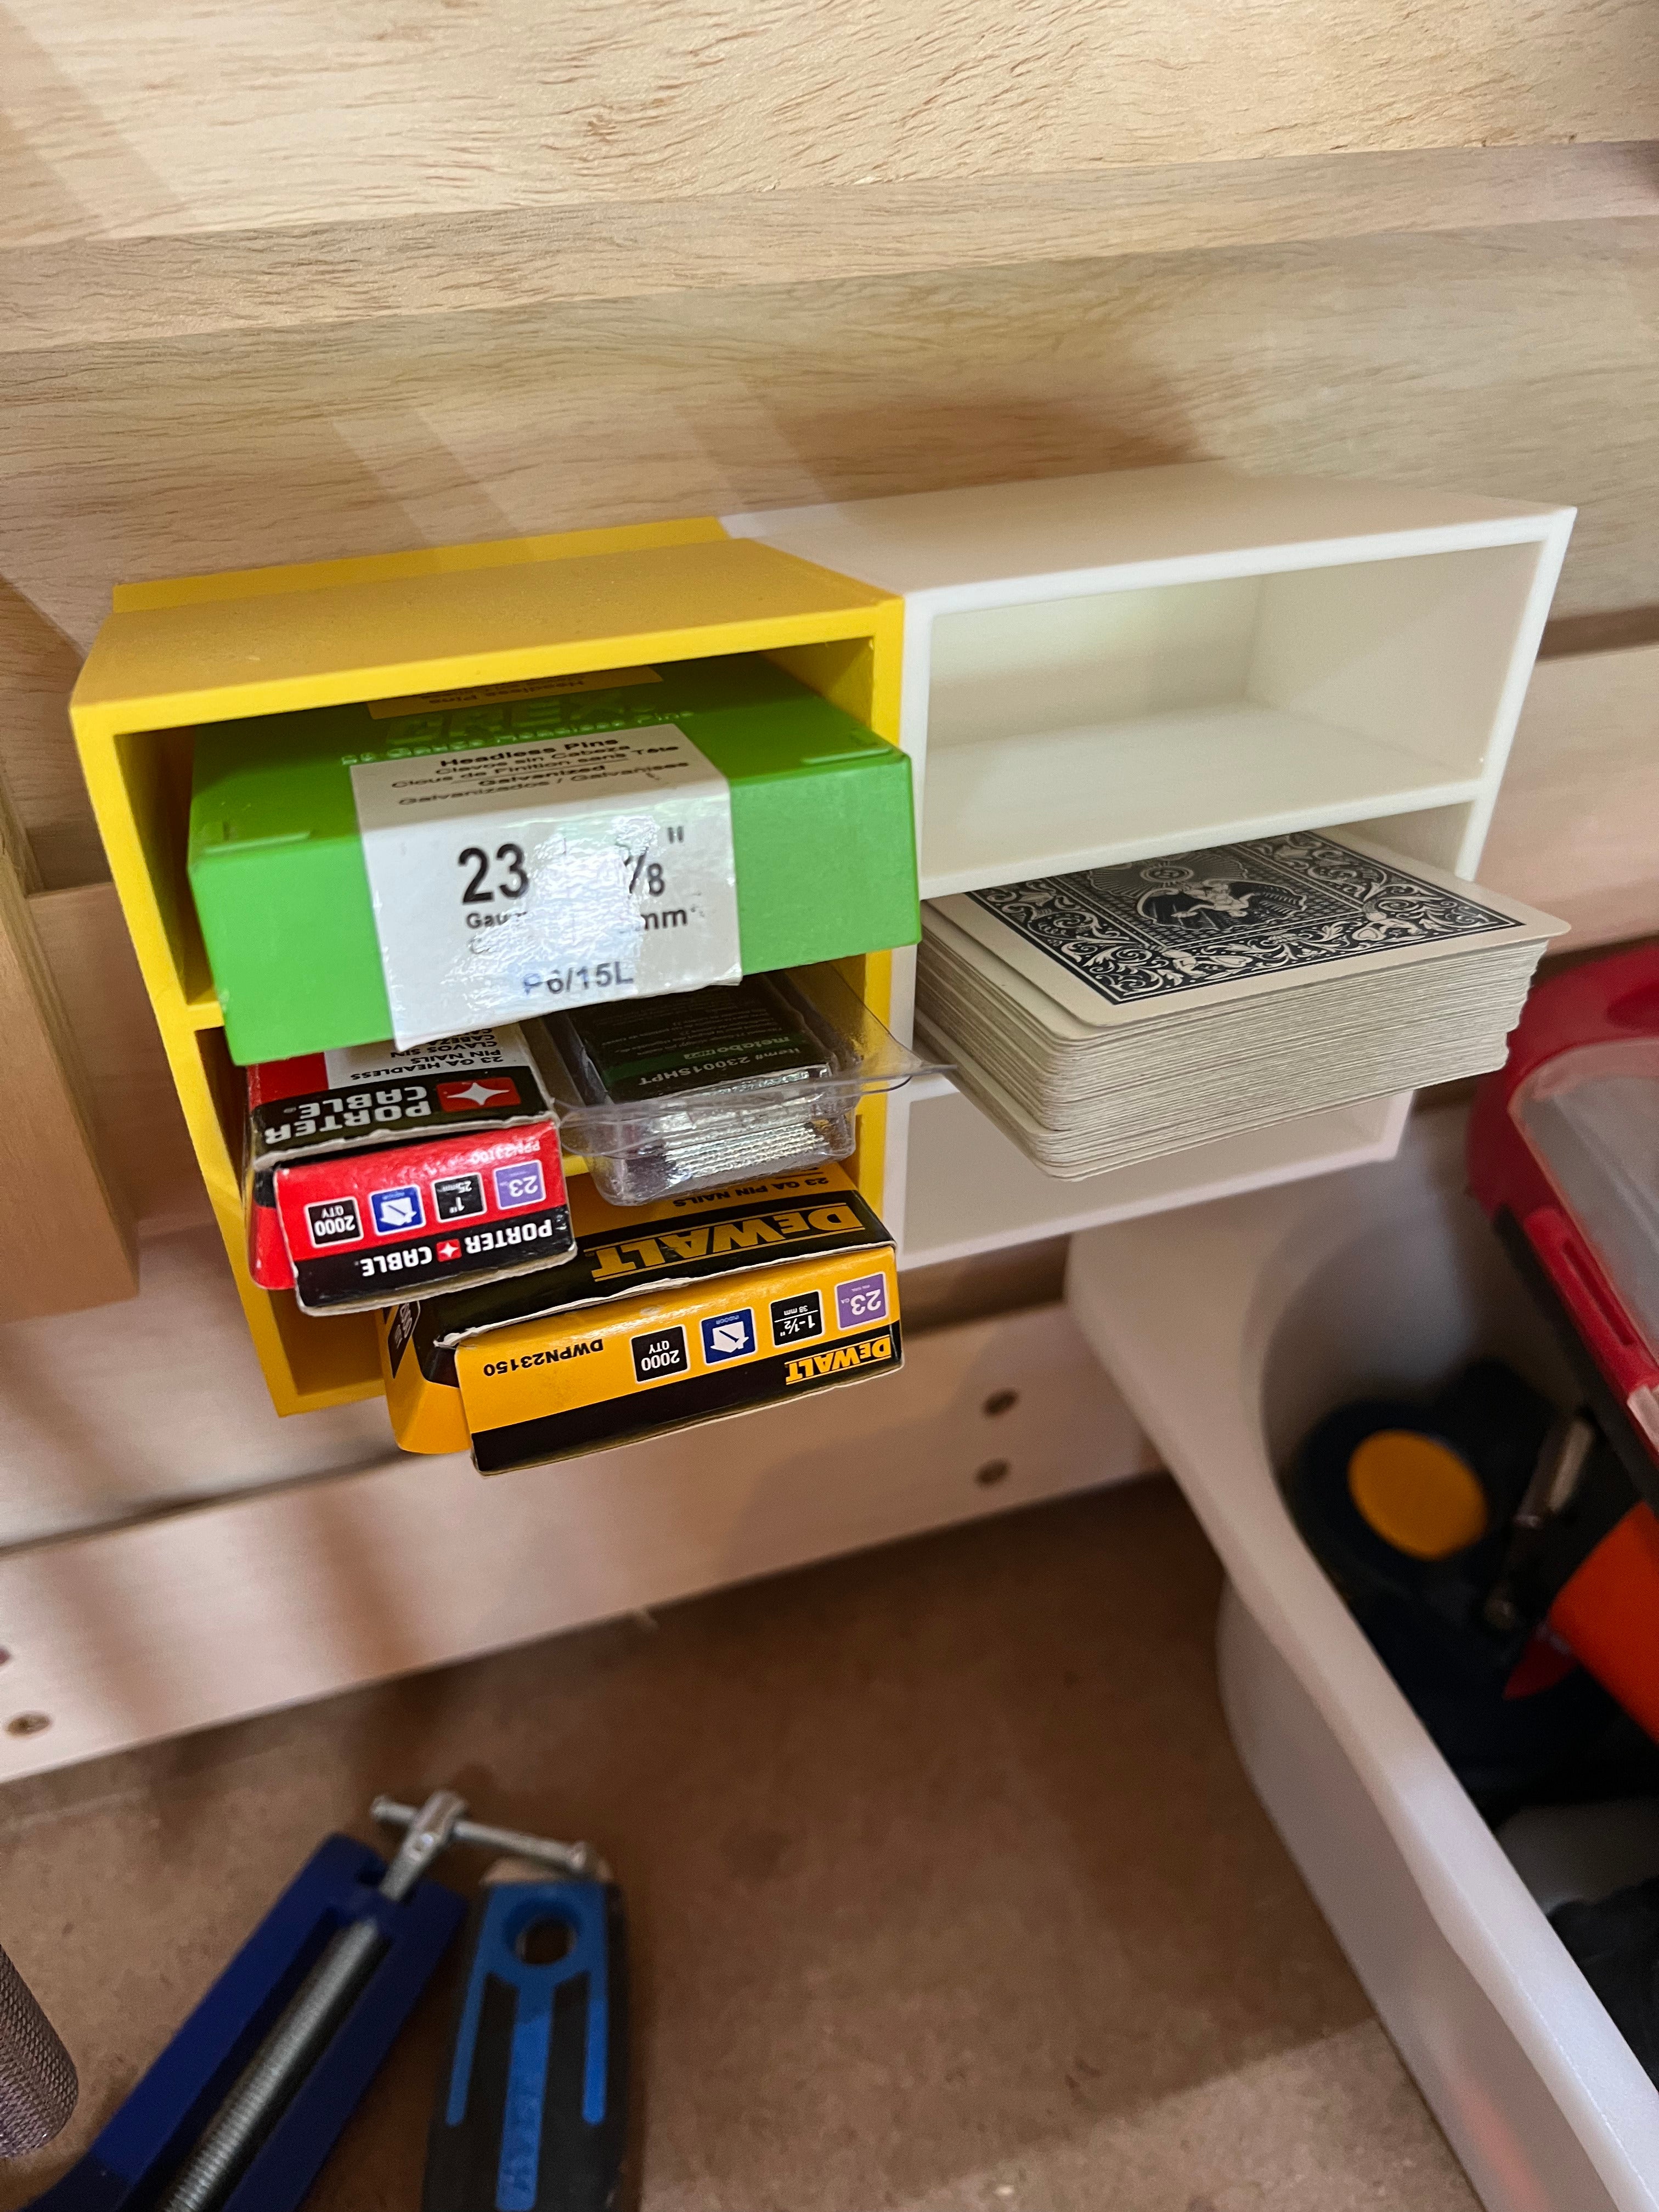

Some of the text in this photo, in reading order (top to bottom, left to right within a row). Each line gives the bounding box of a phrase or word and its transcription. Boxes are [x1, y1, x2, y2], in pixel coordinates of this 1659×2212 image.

[436, 746, 630, 775] Clavos sin Cabeza
[441, 740, 618, 766] Headless Pins
[392, 776, 453, 788] Clous
[578, 753, 626, 763] sans
[478, 765, 606, 786] Galvanized
[399, 781, 550, 805] Galvanizados
[458, 843, 529, 905] 23
[466, 911, 528, 929] Gau
[390, 1041, 497, 1058] CLAVOS SIN
[716, 1036, 790, 1054] metabo
[411, 1049, 501, 1064] PIN NAILS
[445, 1058, 475, 1066] GA
[351, 1062, 441, 1080] HEADLESS
[638, 1056, 751, 1086] 23001SHPT
[298, 1085, 428, 1112] CABLE
[264, 1102, 432, 1145] PORTER
[509, 1175, 538, 1197] 23
[673, 1177, 828, 1207] 23 GA PIN NAILS
[321, 1205, 345, 1218] QTY
[314, 1215, 356, 1237] 2000
[360, 1219, 553, 1277] PORTER CABLE
[783, 1305, 808, 1316] 38 mm
[850, 1289, 881, 1315] 23
[483, 1339, 604, 1376] DWPN23150
[648, 1340, 670, 1355] QTY
[641, 1350, 680, 1372] 2000
